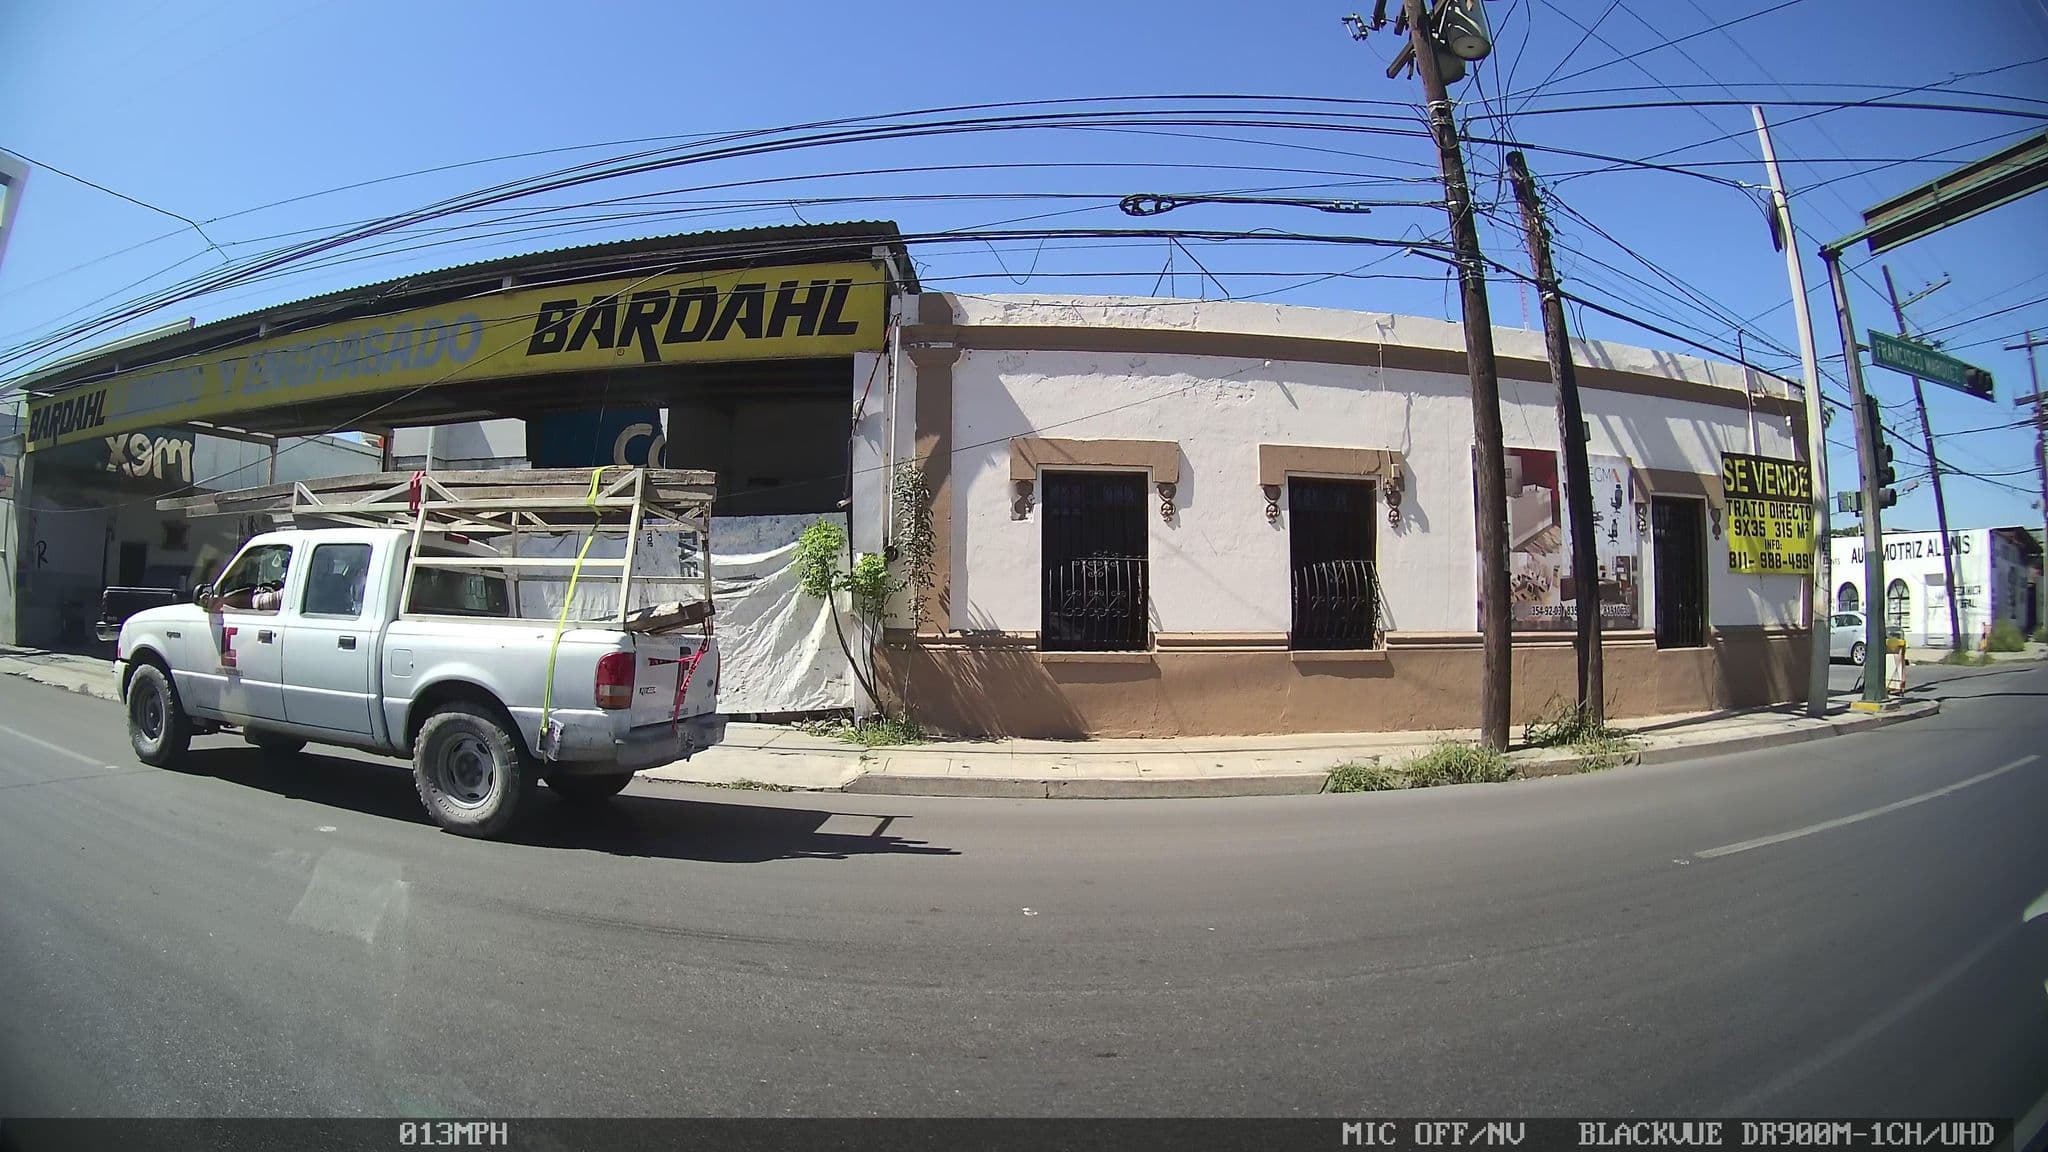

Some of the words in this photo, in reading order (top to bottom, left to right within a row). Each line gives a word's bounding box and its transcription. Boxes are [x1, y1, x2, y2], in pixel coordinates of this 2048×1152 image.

[526, 277, 860, 363] BARDAHL
[27, 389, 107, 444] BARDAHL
[1722, 458, 1749, 493] SE
[1751, 460, 1810, 498] VENDE
[1726, 499, 1766, 519] TRATO
[1769, 502, 1812, 521] DIRECTO
[1734, 519, 1766, 537] 9X35
[1774, 521, 1793, 538] 315
[1764, 540, 1783, 550] INFO:
[1927, 535, 1970, 557] ALNIS
